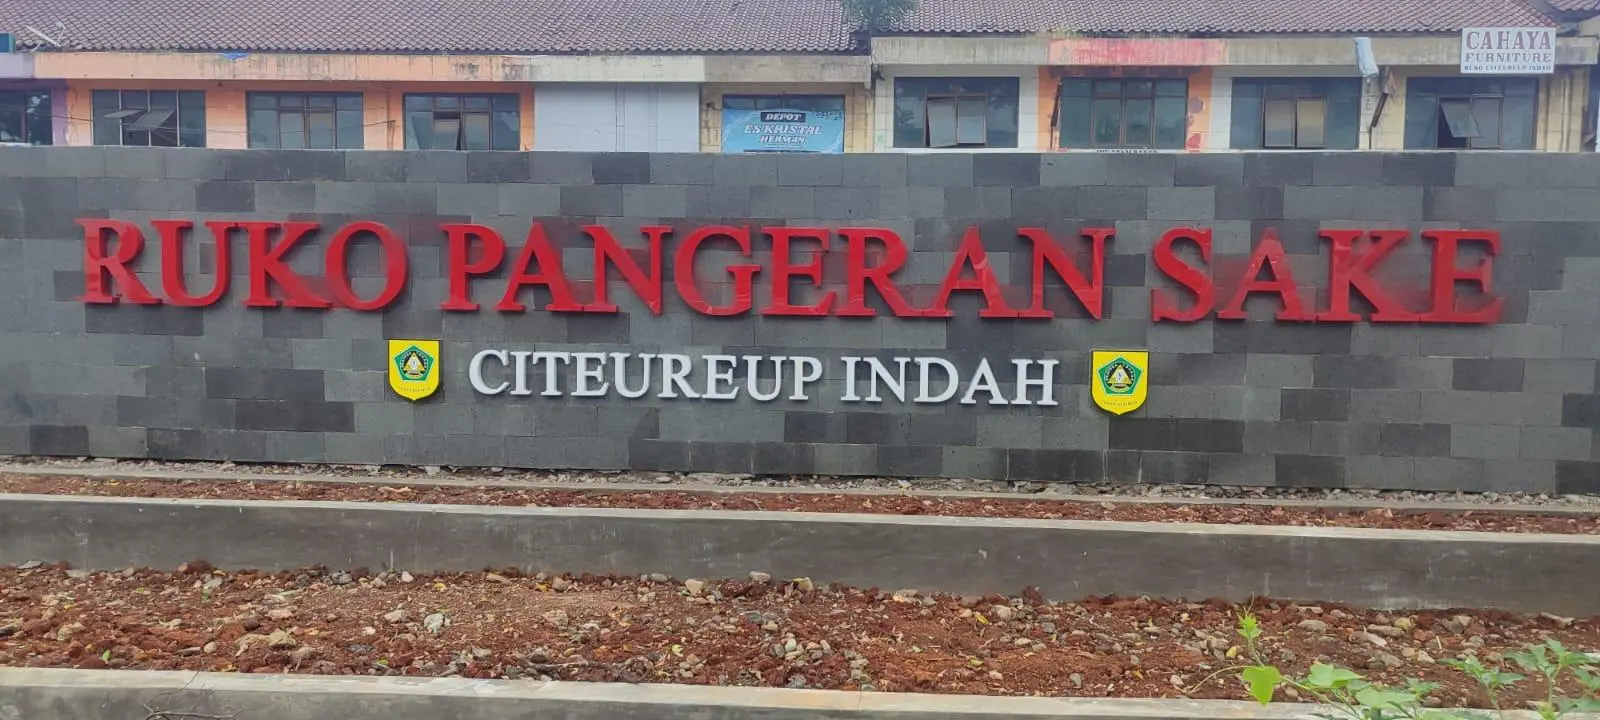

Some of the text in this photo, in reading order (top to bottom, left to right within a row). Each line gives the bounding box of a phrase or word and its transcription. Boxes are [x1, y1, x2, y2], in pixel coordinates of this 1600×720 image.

[1466, 31, 1551, 50] CAHAYA
[1466, 53, 1551, 62] FURNITURE
[764, 113, 802, 121] DEPOT
[743, 124, 823, 135] ES KRISTAL
[759, 135, 806, 144] HERMAN
[75, 218, 1507, 325] RUKO PANGERAN SAKE
[468, 349, 1060, 406] CITEUREUP INDAH
